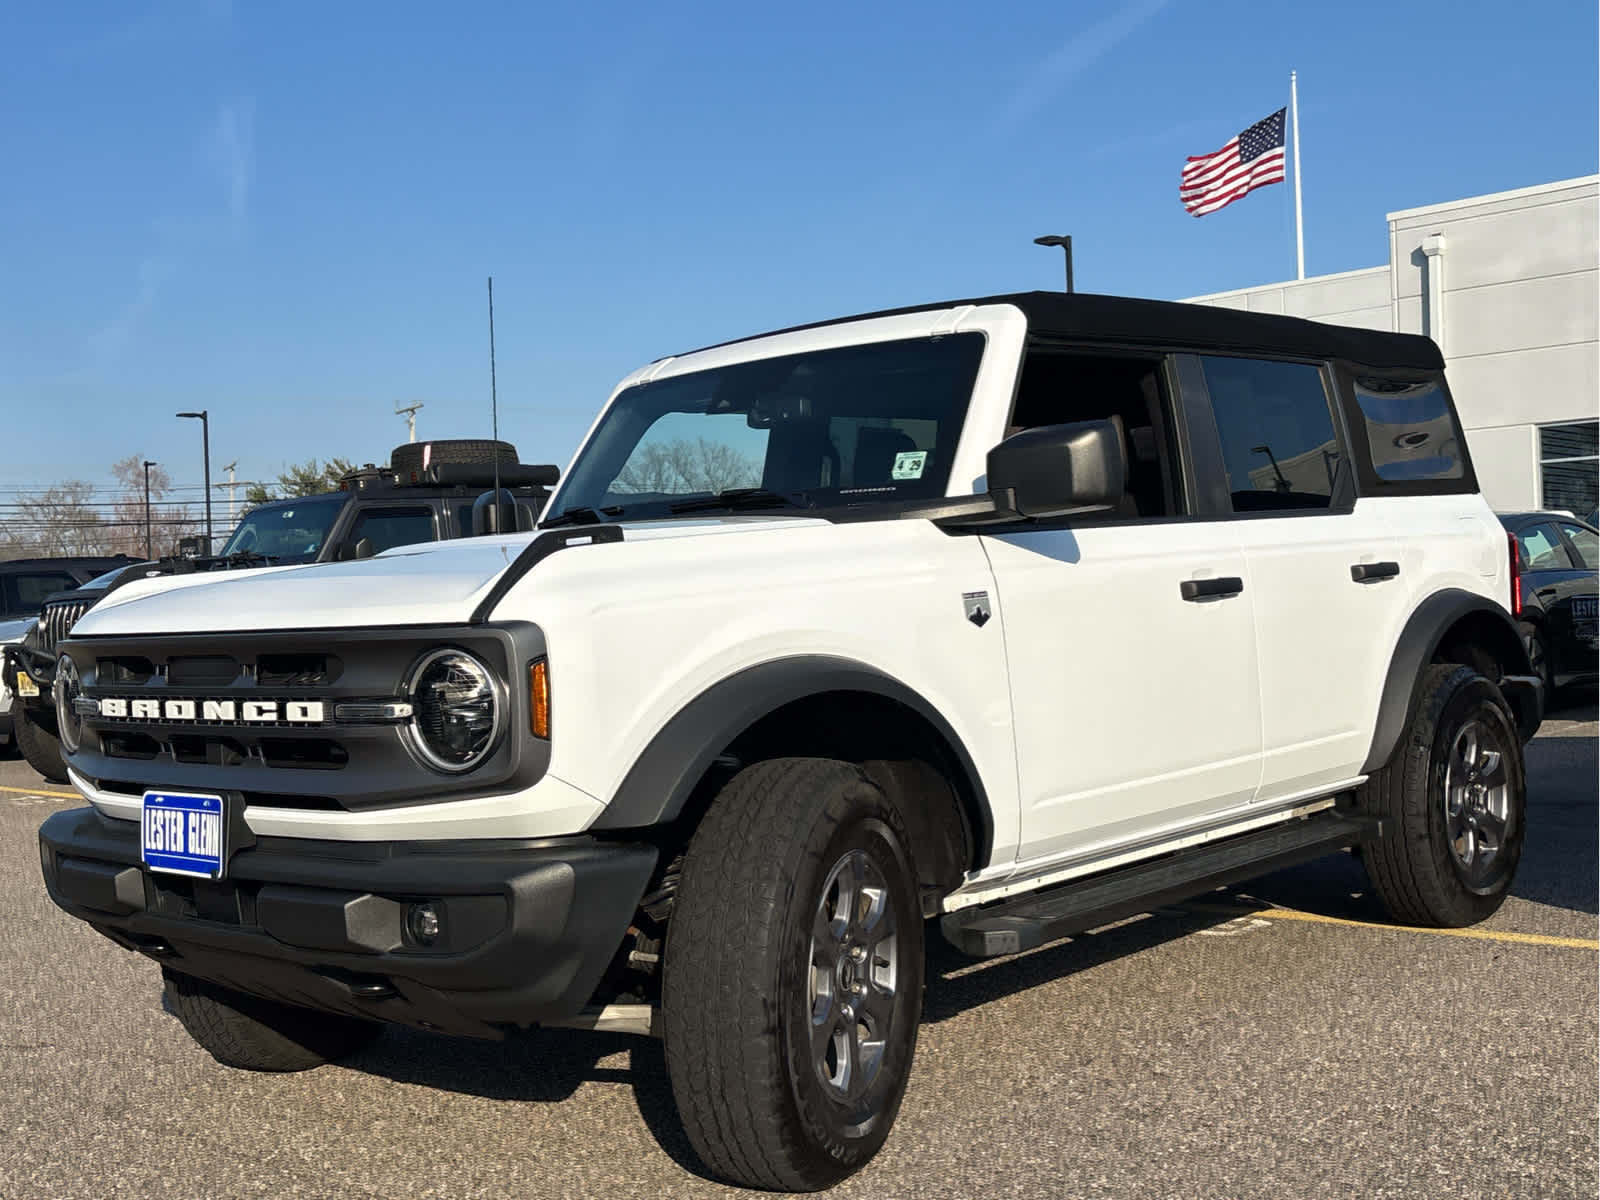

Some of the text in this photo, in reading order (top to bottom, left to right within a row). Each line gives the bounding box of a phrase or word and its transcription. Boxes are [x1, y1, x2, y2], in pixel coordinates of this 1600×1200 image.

[897, 460, 922, 471] 4 29
[1571, 599, 1599, 617] LESTE
[101, 698, 324, 722] BRONCO
[145, 808, 219, 857] LESTER GLENN
